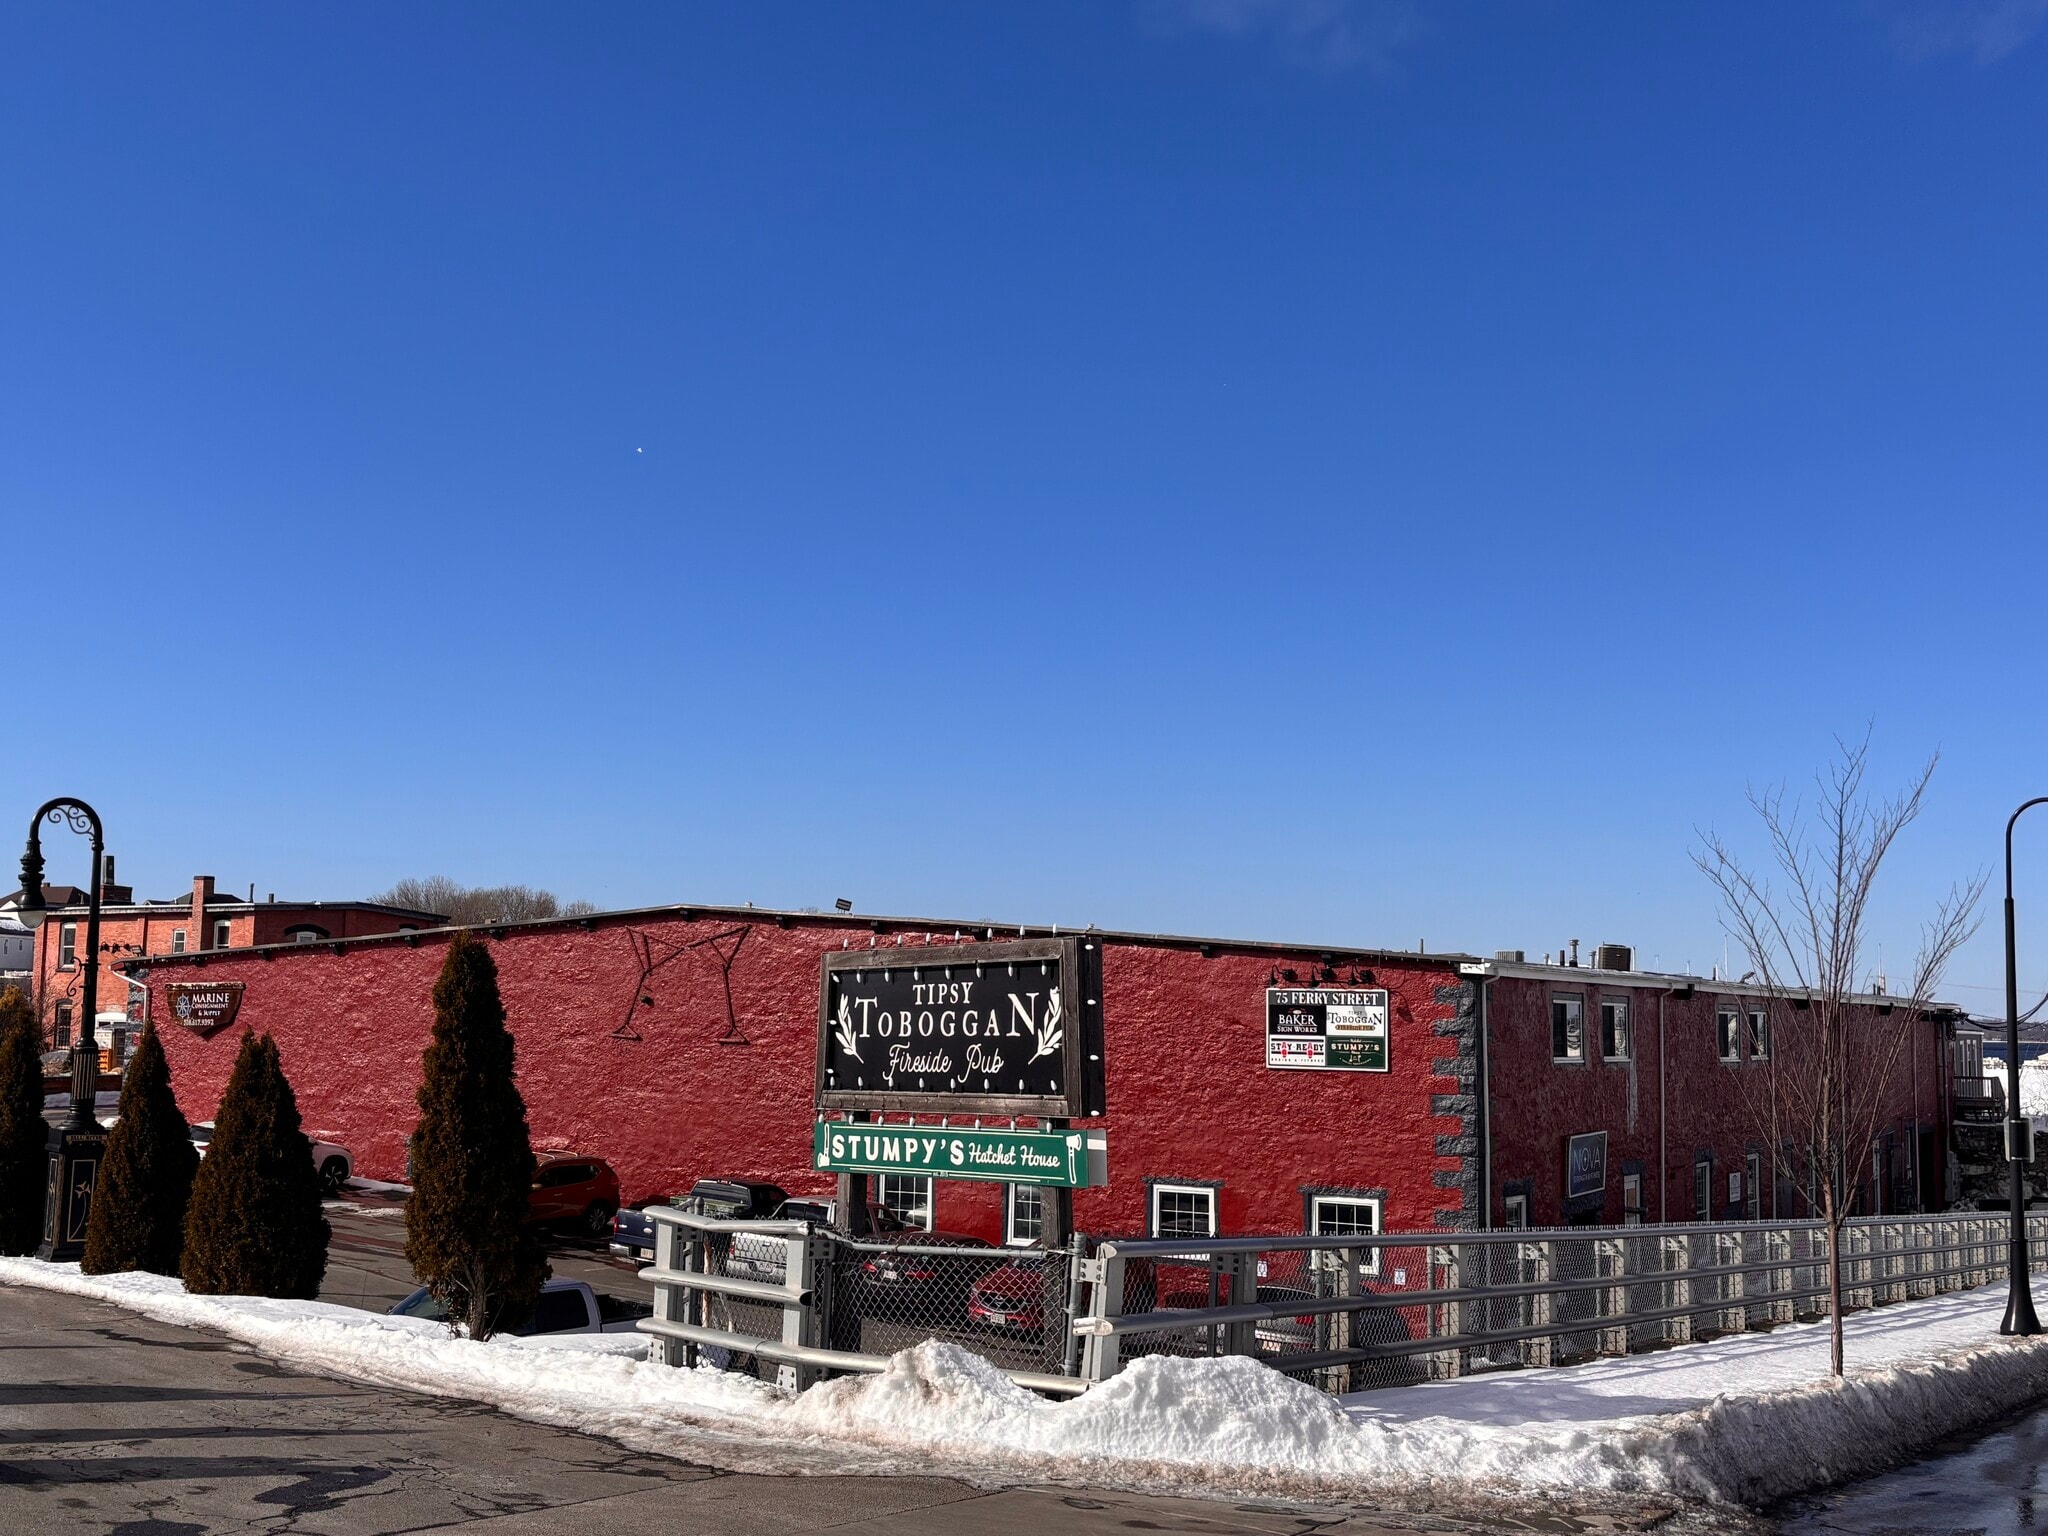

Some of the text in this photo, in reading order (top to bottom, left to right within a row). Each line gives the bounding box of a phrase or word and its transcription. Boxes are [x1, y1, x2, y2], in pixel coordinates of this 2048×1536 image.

[192, 993, 230, 1003] MARINE
[912, 981, 974, 1006] TIPSY
[1275, 992, 1379, 1006] 75 FERRY STREET
[854, 992, 1040, 1038] TOBOGGAN
[1278, 1014, 1318, 1027] BAKER
[1327, 1012, 1383, 1025] TOBOGGAN
[1270, 1042, 1324, 1052] STAY READY
[1331, 1043, 1380, 1051] STUMPY'S
[882, 1041, 1004, 1083] Fireside Pub
[832, 1134, 1061, 1168] STUMPY'S Hatchet House
[1573, 1146, 1601, 1173] NOVA
